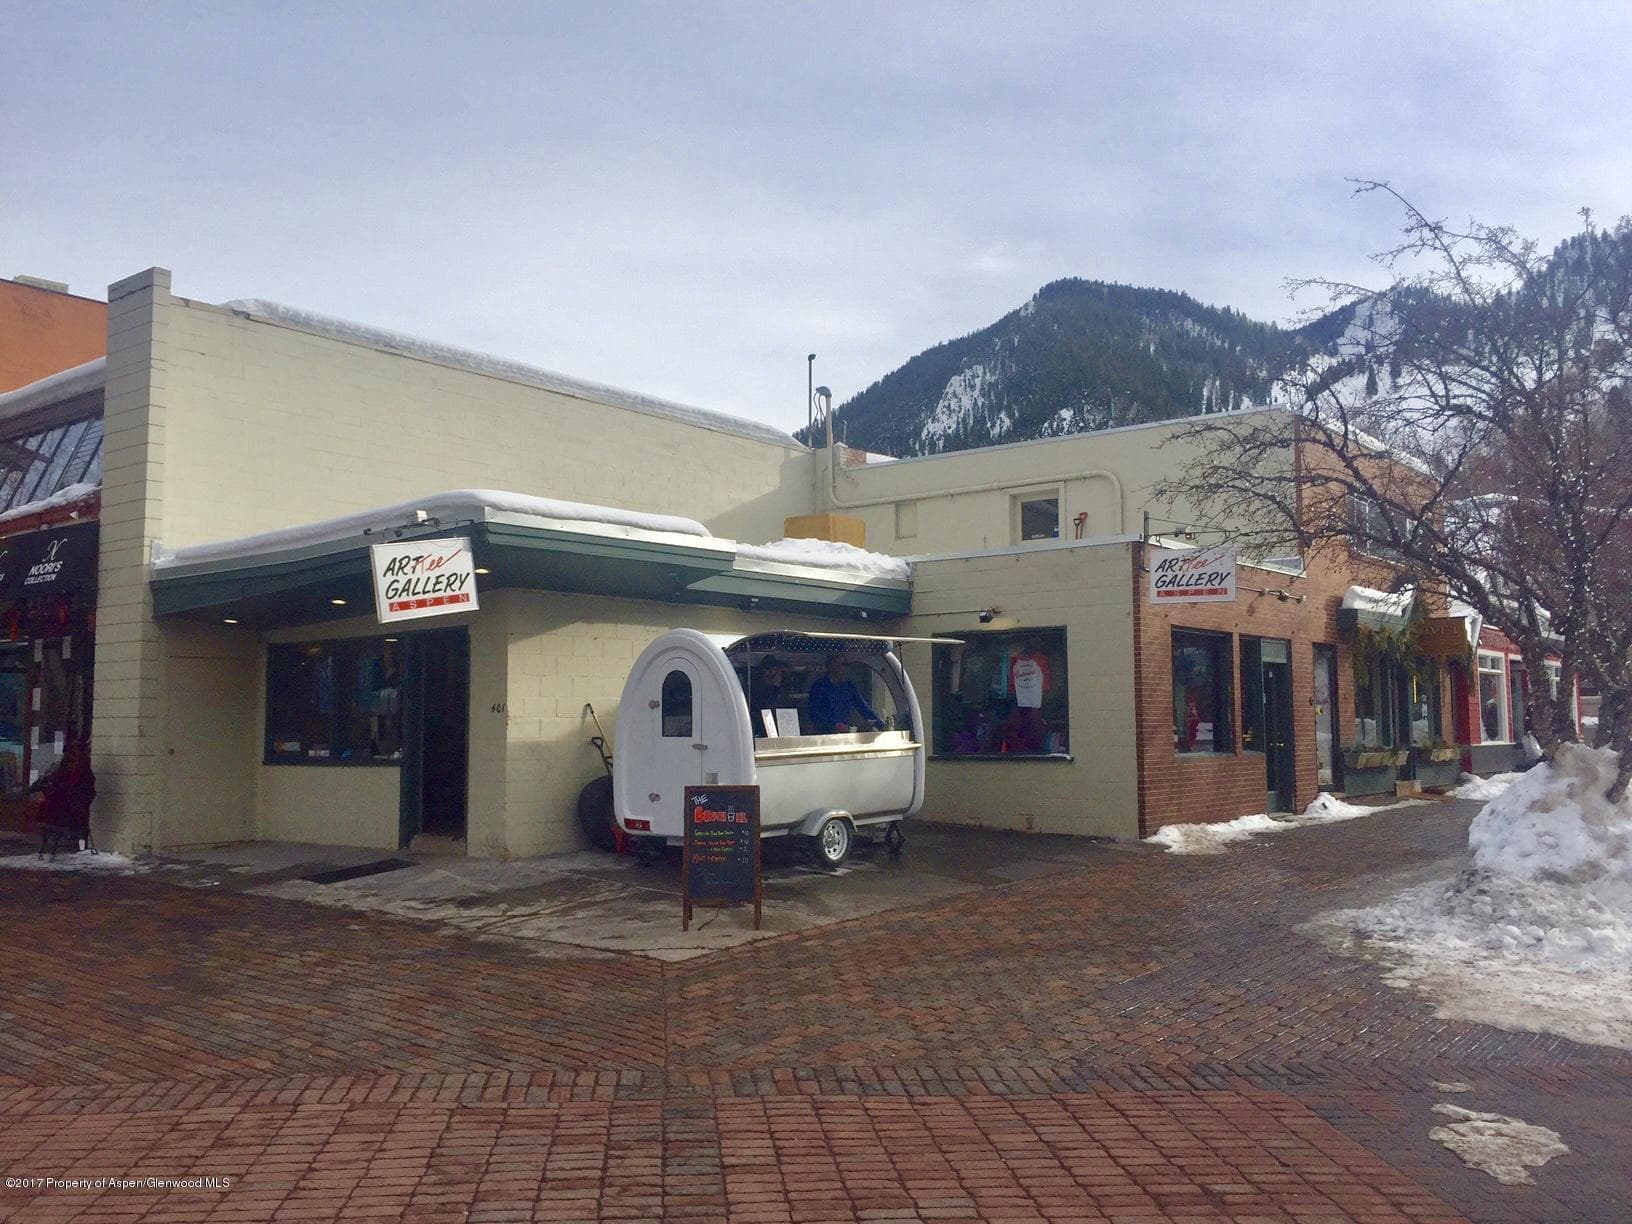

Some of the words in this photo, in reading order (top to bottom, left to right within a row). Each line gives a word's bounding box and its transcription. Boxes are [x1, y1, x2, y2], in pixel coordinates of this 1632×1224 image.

[24, 573, 57, 585] COLLECTION
[385, 572, 470, 600] GALLERY
[1155, 572, 1230, 588] GALLERY
[1159, 588, 1226, 597] ASPEN
[391, 594, 468, 611] ASPEN
[691, 794, 708, 805] THE
